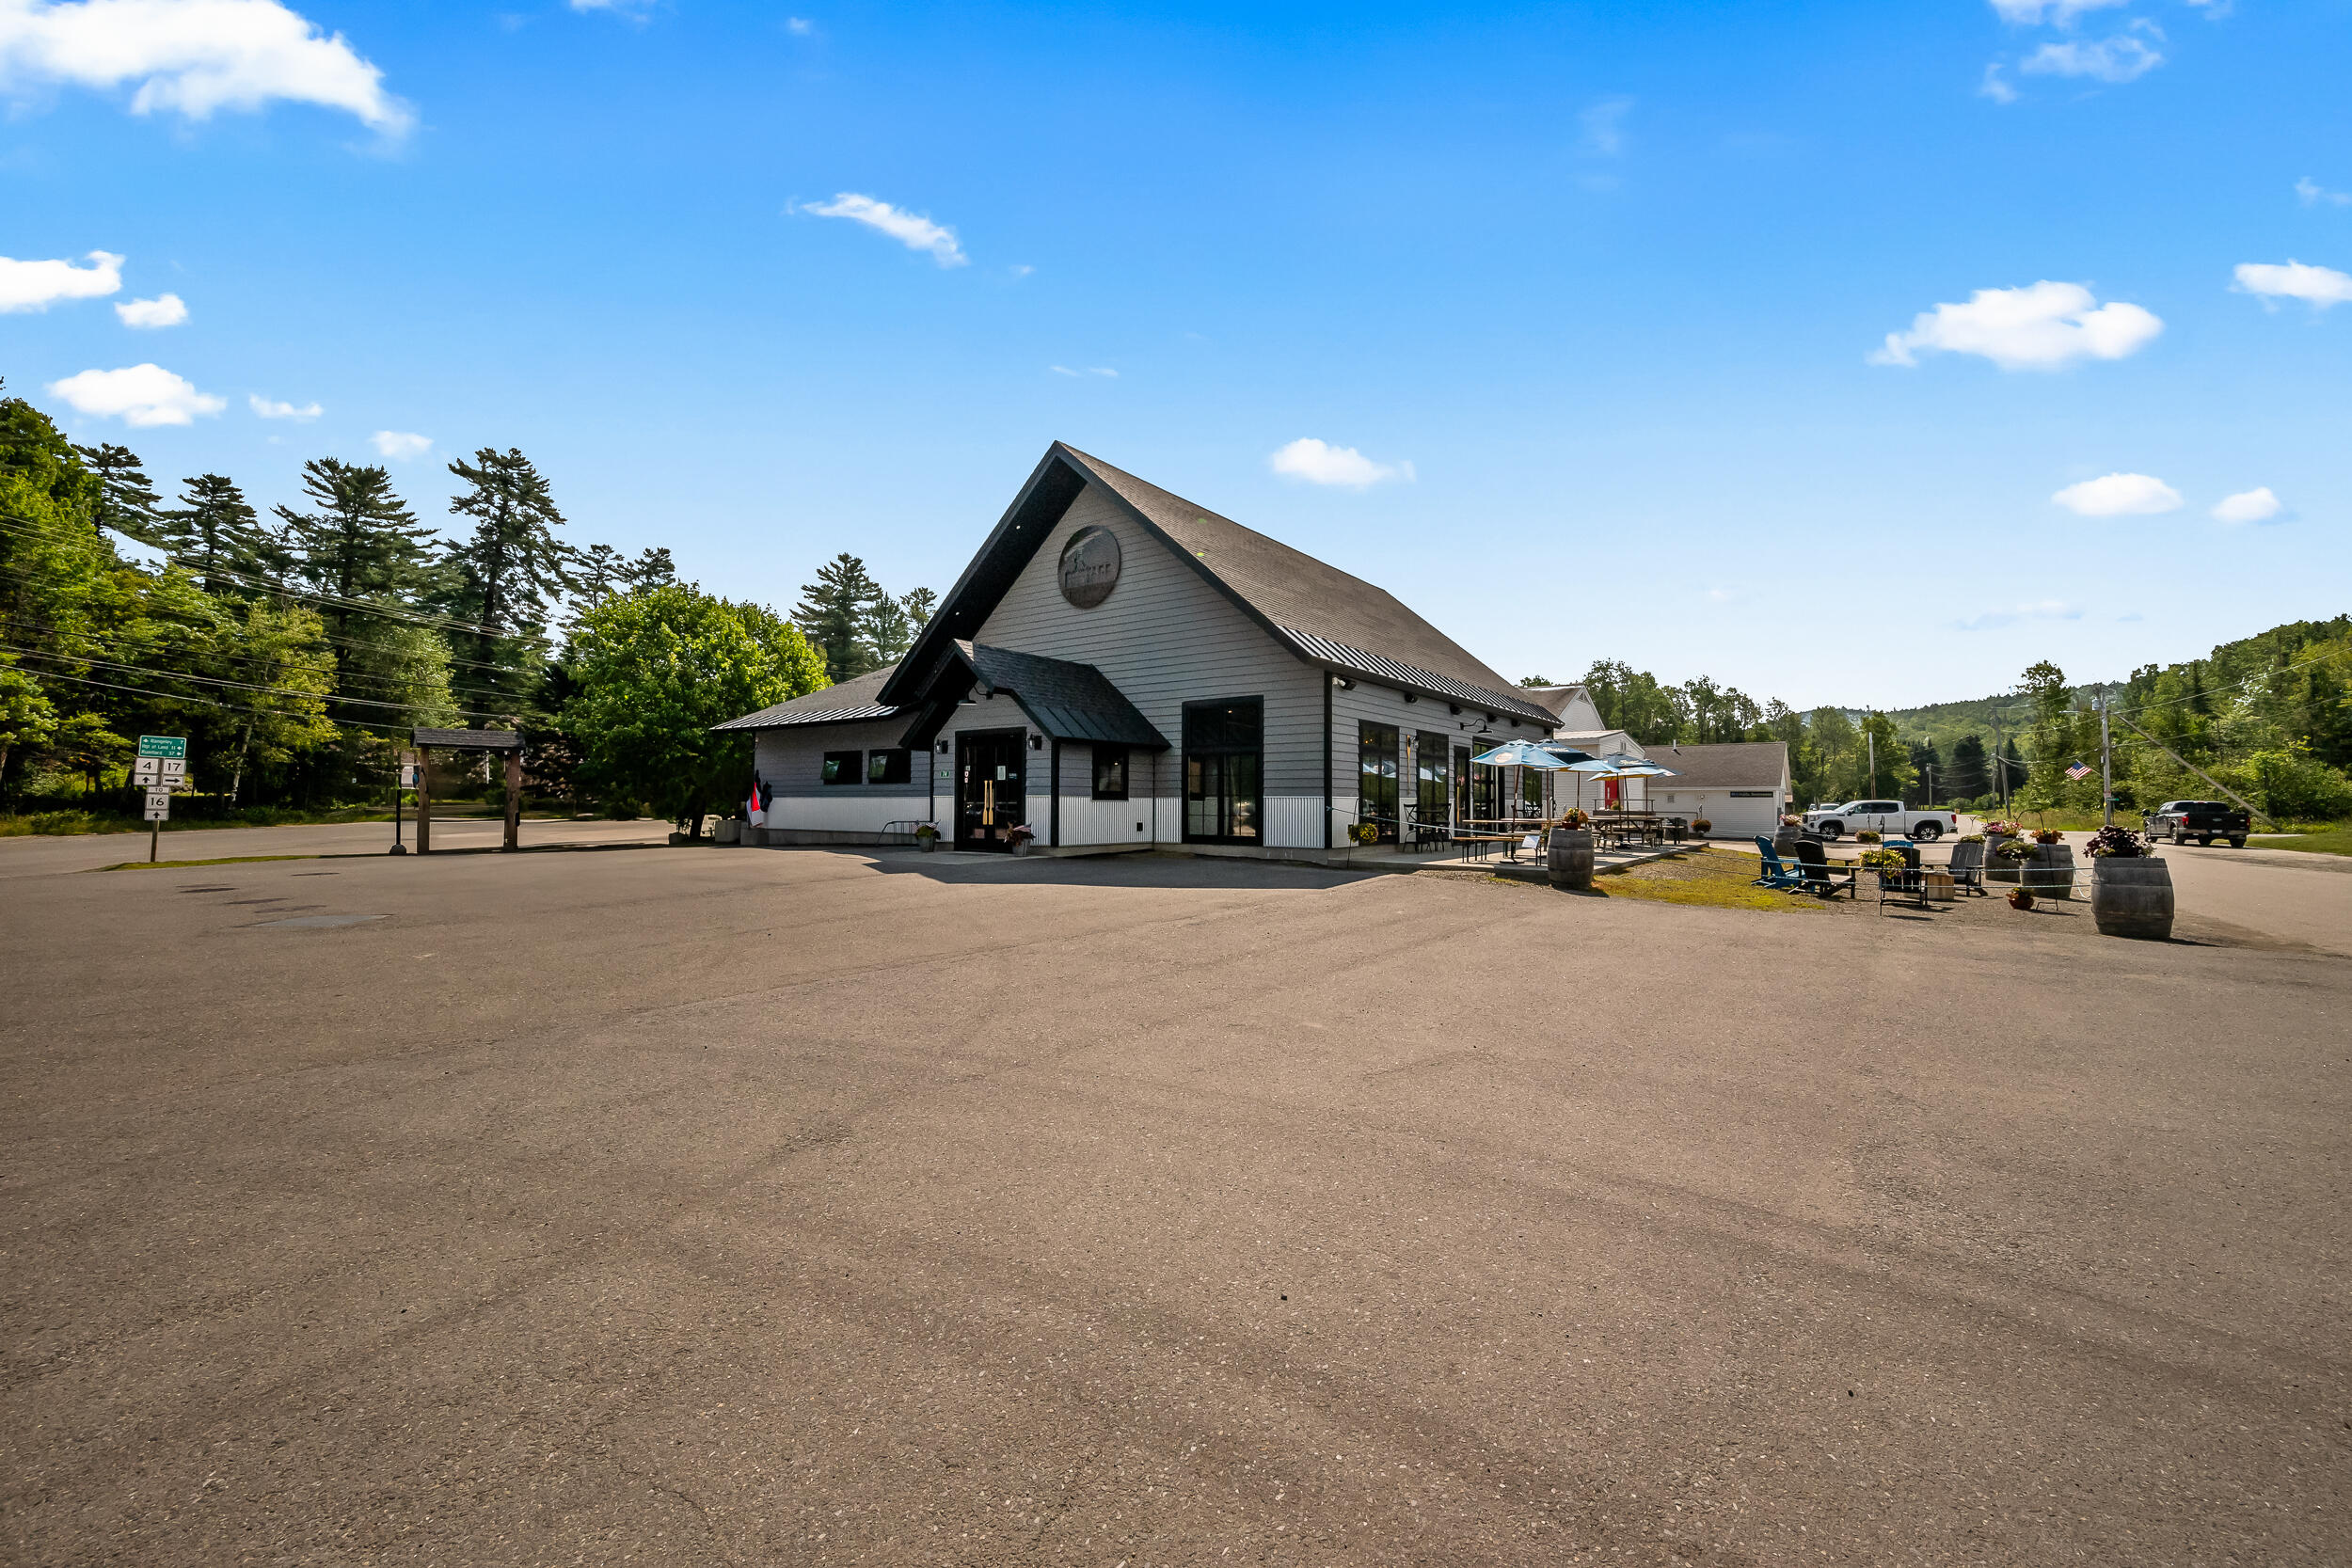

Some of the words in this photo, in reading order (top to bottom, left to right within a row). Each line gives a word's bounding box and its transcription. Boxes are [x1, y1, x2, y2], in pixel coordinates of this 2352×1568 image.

[143, 761, 151, 770] 4
[167, 763, 182, 771] 17
[151, 798, 165, 806] 16
